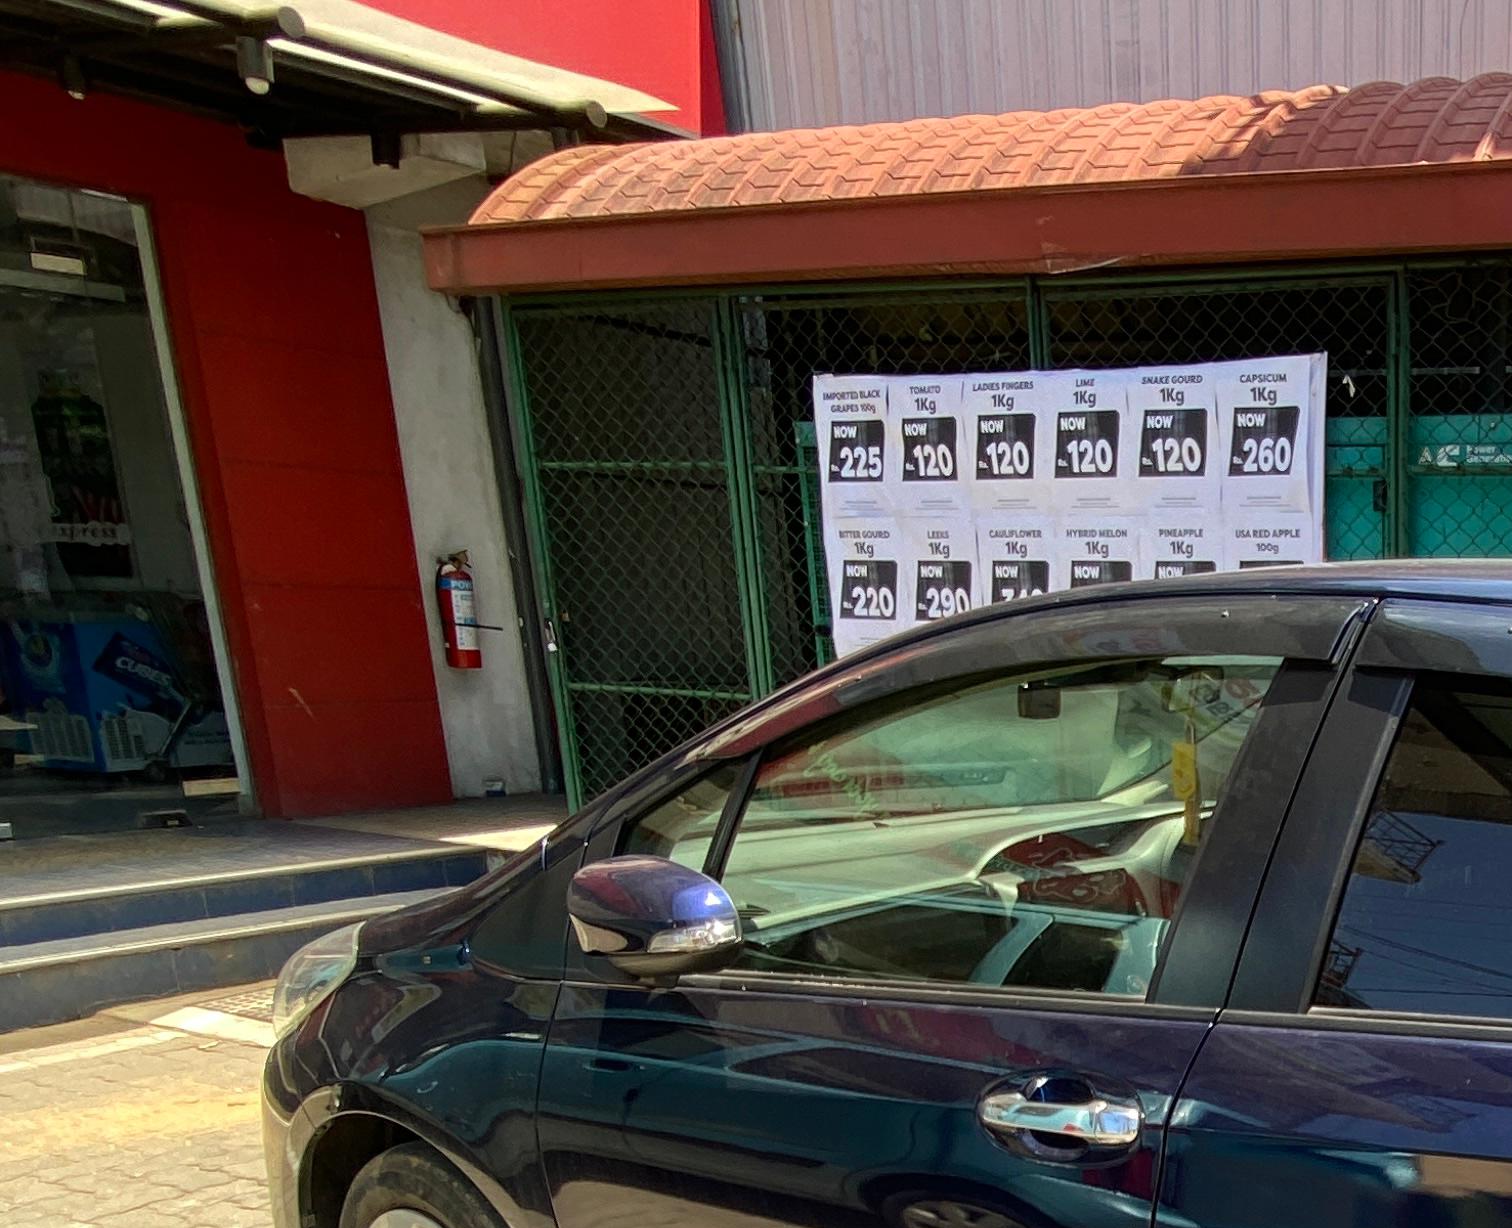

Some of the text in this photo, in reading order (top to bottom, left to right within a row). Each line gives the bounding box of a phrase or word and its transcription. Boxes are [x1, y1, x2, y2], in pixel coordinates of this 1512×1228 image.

[1075, 379, 1095, 387] LIME
[1141, 375, 1203, 384] SNAKE GOURD
[1239, 374, 1288, 383] CAPSICUM
[909, 385, 941, 394] TOMATO
[972, 381, 1034, 392] LADIES FINGERS
[823, 389, 881, 401] IMPORTED BLACK
[1073, 390, 1097, 408] 1Kg
[1160, 387, 1185, 406] 1Kg
[1250, 386, 1278, 404] 1Kg
[830, 404, 859, 413] GRAPES
[914, 398, 937, 414] 1Kg
[991, 394, 1015, 411] 1Kg
[980, 419, 1004, 433] NOW
[1060, 416, 1086, 430] NOW
[1146, 415, 1174, 429] NOW
[1236, 413, 1266, 427] NOW
[833, 425, 857, 439] NOW
[904, 422, 928, 436] NOW
[913, 443, 954, 477] 120
[986, 441, 1030, 475] 120
[1067, 439, 1113, 473] 120
[1152, 437, 1202, 472] 120
[1242, 436, 1292, 472] 260
[839, 446, 882, 478] 225
[838, 530, 890, 539] BITTER GOURD
[927, 530, 949, 539] LEEKS
[989, 529, 1042, 538] CAULIFLOWER
[1066, 529, 1128, 538] HYBRID MELON
[1159, 529, 1204, 538] PINEAPPLE
[1235, 529, 1300, 538] USA RED APPLE
[854, 542, 874, 558] 1Kg
[928, 542, 950, 558] 1Kg
[1005, 541, 1028, 558] 1Kg
[1085, 541, 1109, 558] 1Kg
[1169, 541, 1194, 558] 1Kg
[1256, 543, 1279, 554] 100g
[846, 565, 868, 577] NOW
[920, 565, 944, 578] NOW
[995, 565, 1019, 578] NOW
[1073, 565, 1100, 579] NOW
[1158, 566, 1184, 579] NOW
[851, 584, 895, 618] 220
[926, 587, 970, 618] 290
